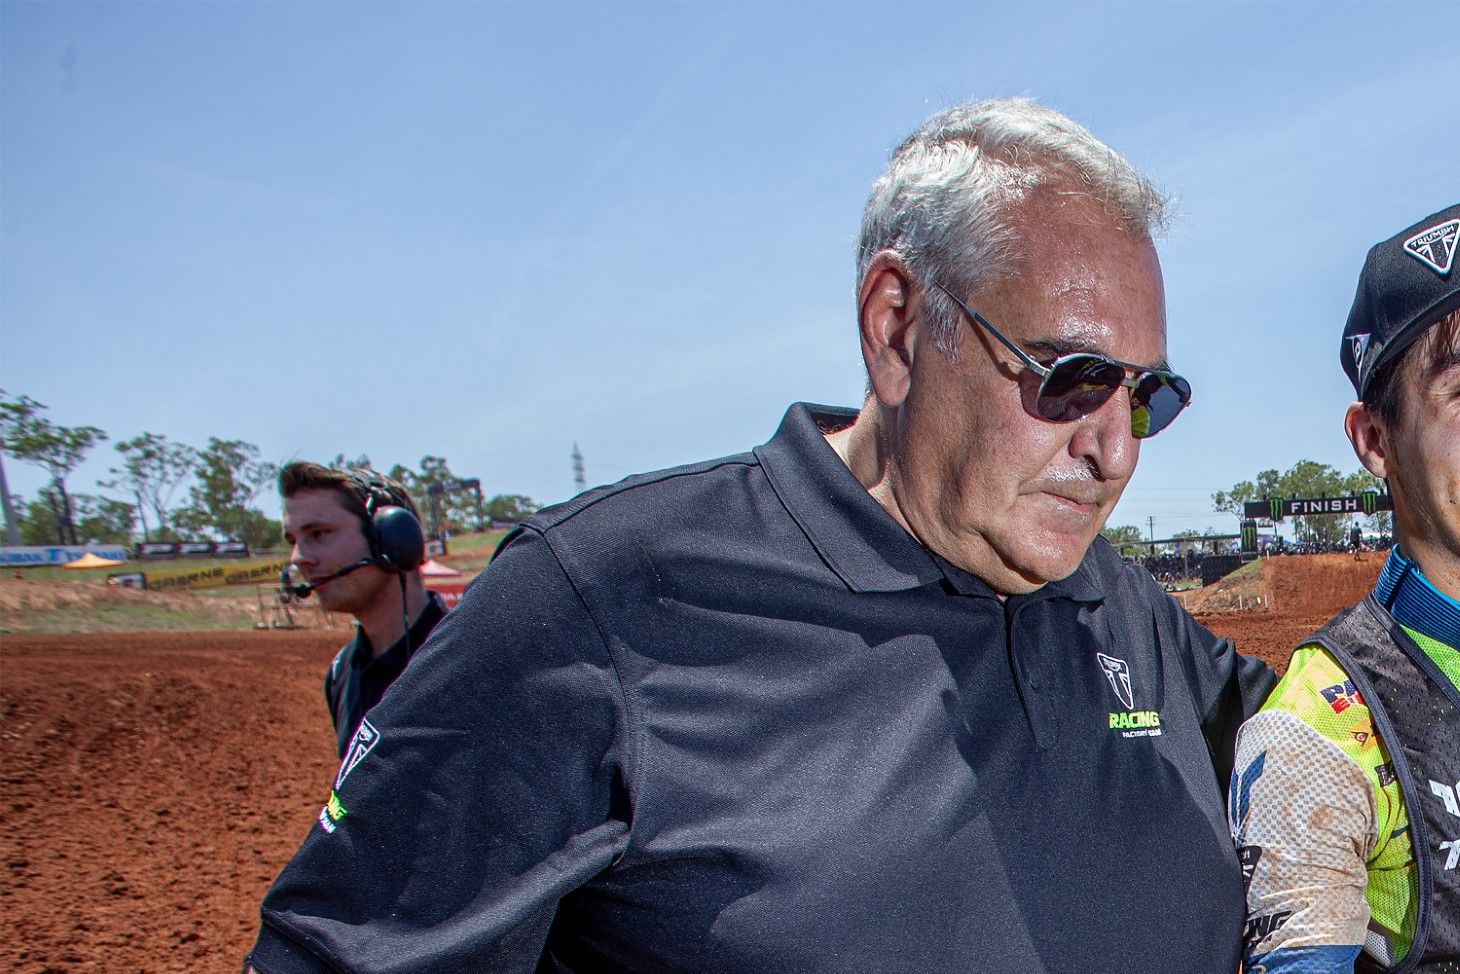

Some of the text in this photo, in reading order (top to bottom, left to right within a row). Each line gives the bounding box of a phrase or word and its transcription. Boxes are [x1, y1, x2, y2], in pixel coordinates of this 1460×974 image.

[1410, 225, 1455, 248] TRIUMPH
[1291, 500, 1358, 514] FINISH
[1108, 711, 1161, 729] RACING
